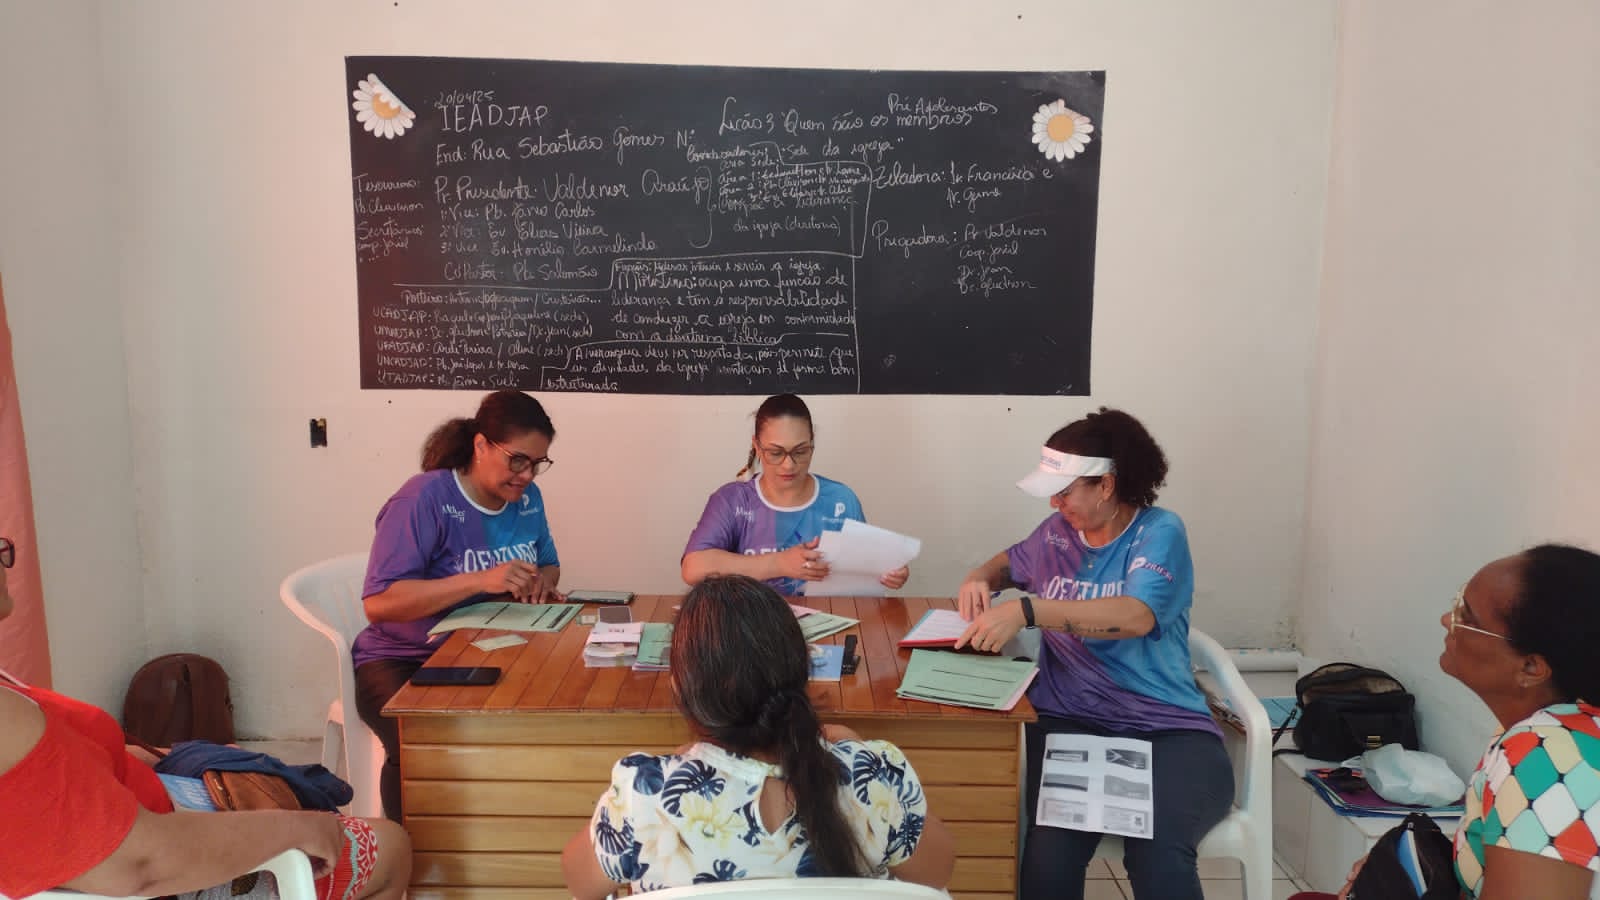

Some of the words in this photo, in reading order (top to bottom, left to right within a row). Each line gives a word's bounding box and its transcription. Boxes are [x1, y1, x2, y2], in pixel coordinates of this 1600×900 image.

[439, 104, 548, 133] IEADJAP
[766, 113, 775, 133] 3
[472, 138, 511, 160] Rua
